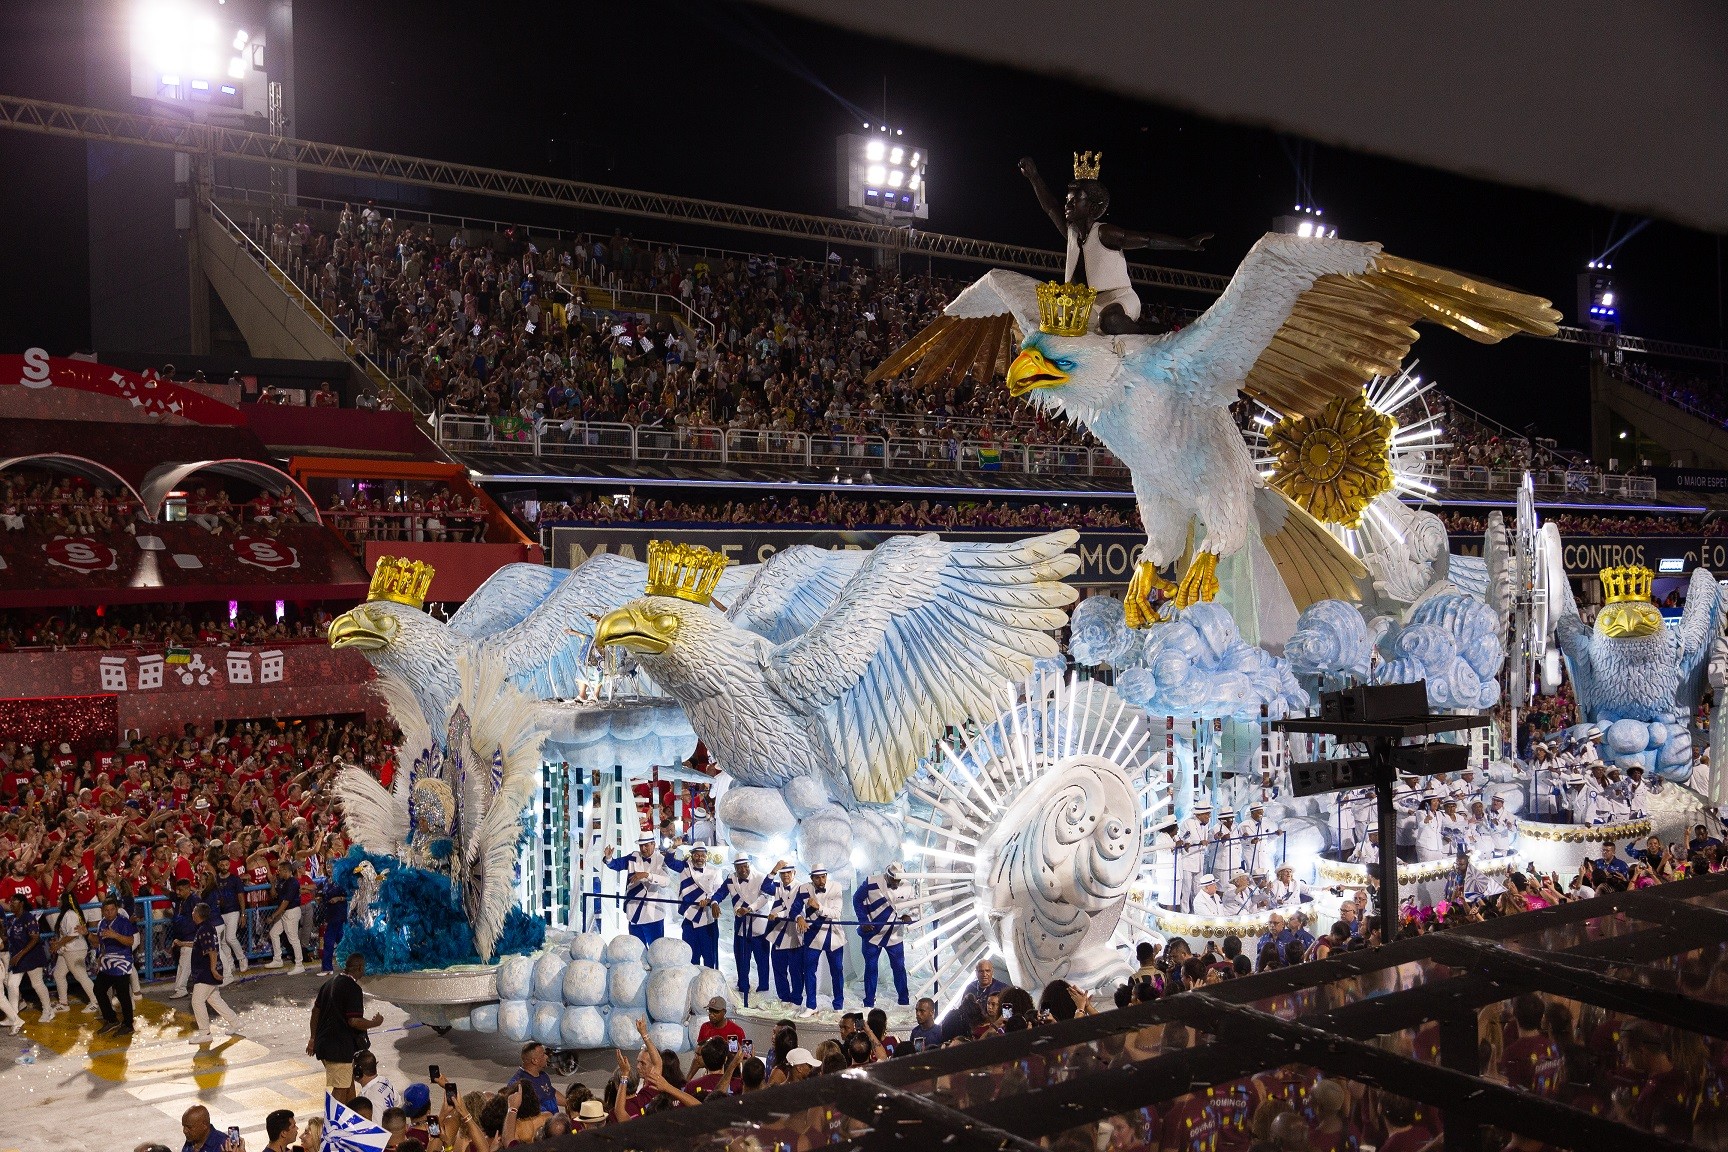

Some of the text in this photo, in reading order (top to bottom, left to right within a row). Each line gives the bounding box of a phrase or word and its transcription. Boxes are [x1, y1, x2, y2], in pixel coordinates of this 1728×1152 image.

[22, 346, 51, 381] S
[1677, 474, 1728, 488] O MAIOR ESPET
[64, 543, 95, 560] S
[249, 542, 278, 558] S
[1563, 544, 1645, 570] CONTROS
[1701, 538, 1711, 568] É
[1713, 544, 1726, 568] O
[254, 866, 268, 876] RIO
[14, 885, 32, 895] RIO
[1209, 1098, 1247, 1108] DOMINGO
